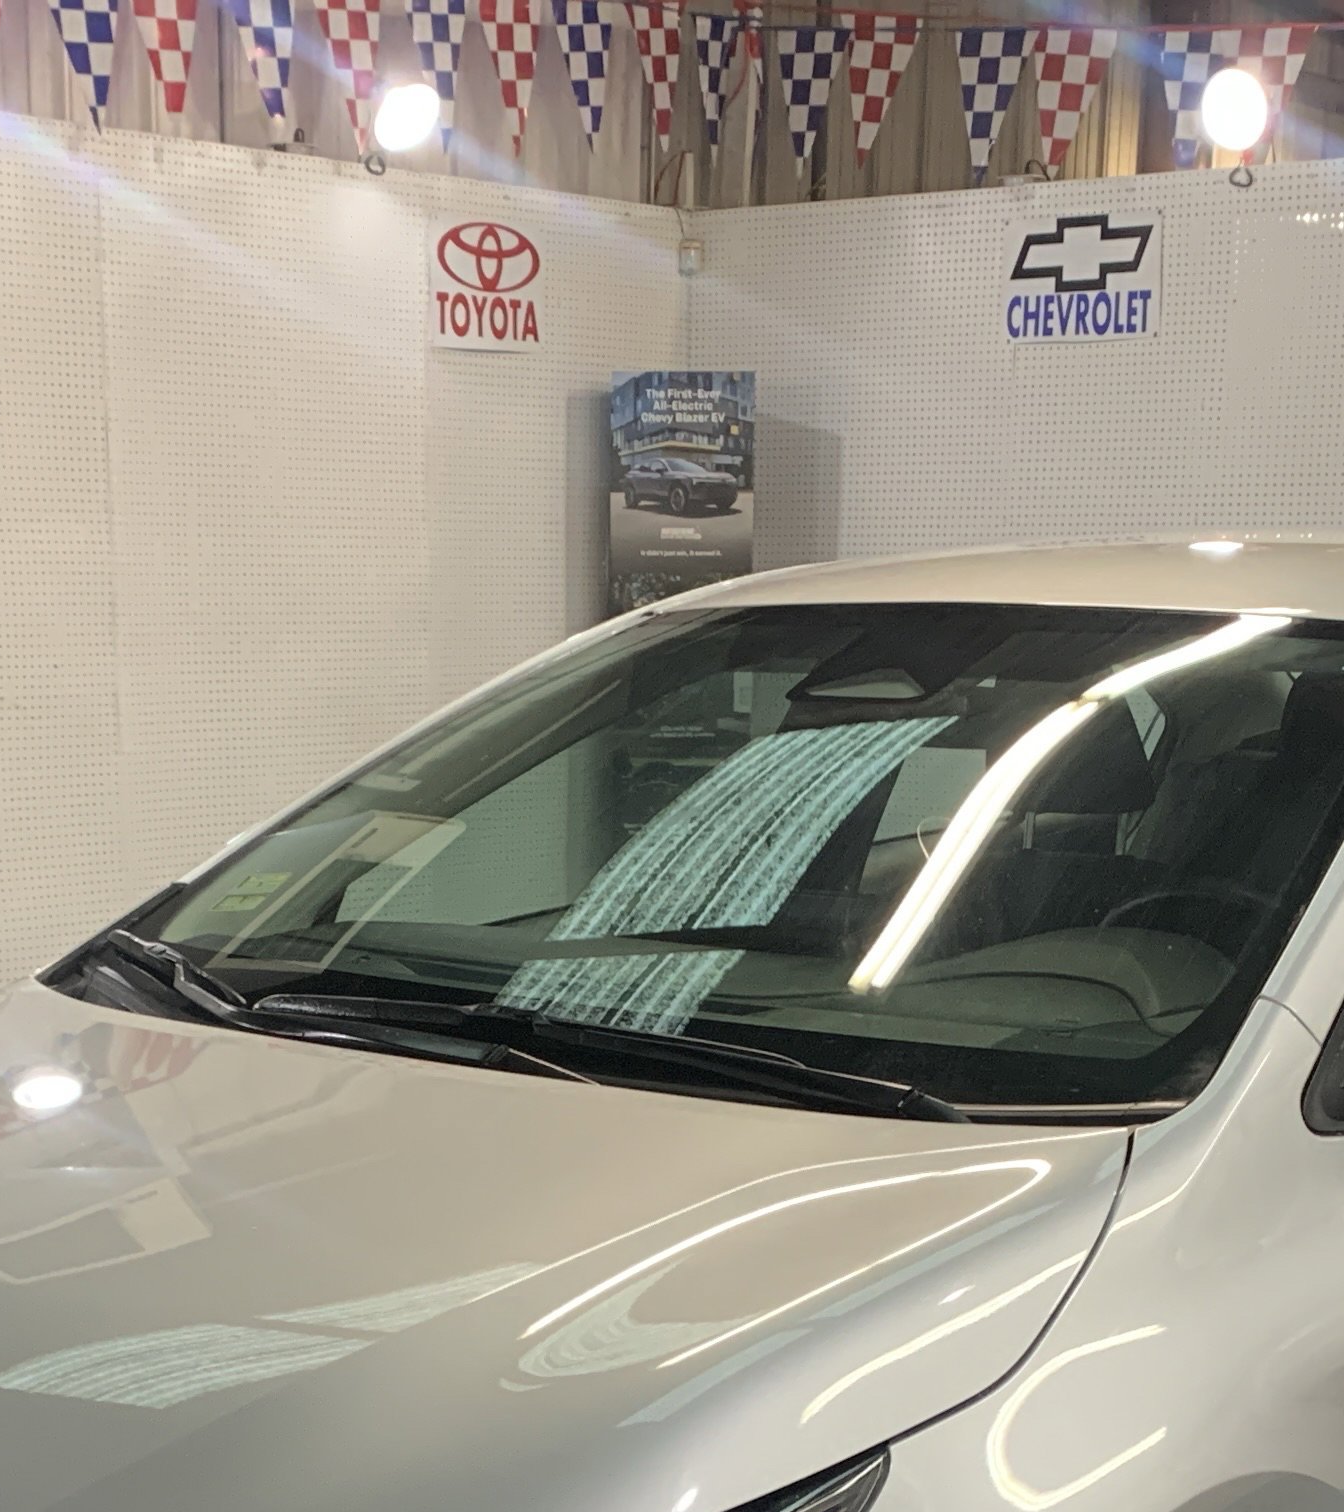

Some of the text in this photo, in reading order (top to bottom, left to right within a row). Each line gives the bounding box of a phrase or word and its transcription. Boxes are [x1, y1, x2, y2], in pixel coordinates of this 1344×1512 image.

[436, 291, 539, 343] TOYOTA
[1007, 290, 1152, 338] CHEVROLET
[646, 388, 721, 400] The First-Ever
[653, 400, 713, 411] All-Electric
[640, 412, 725, 424] Chevy Blazer EV
